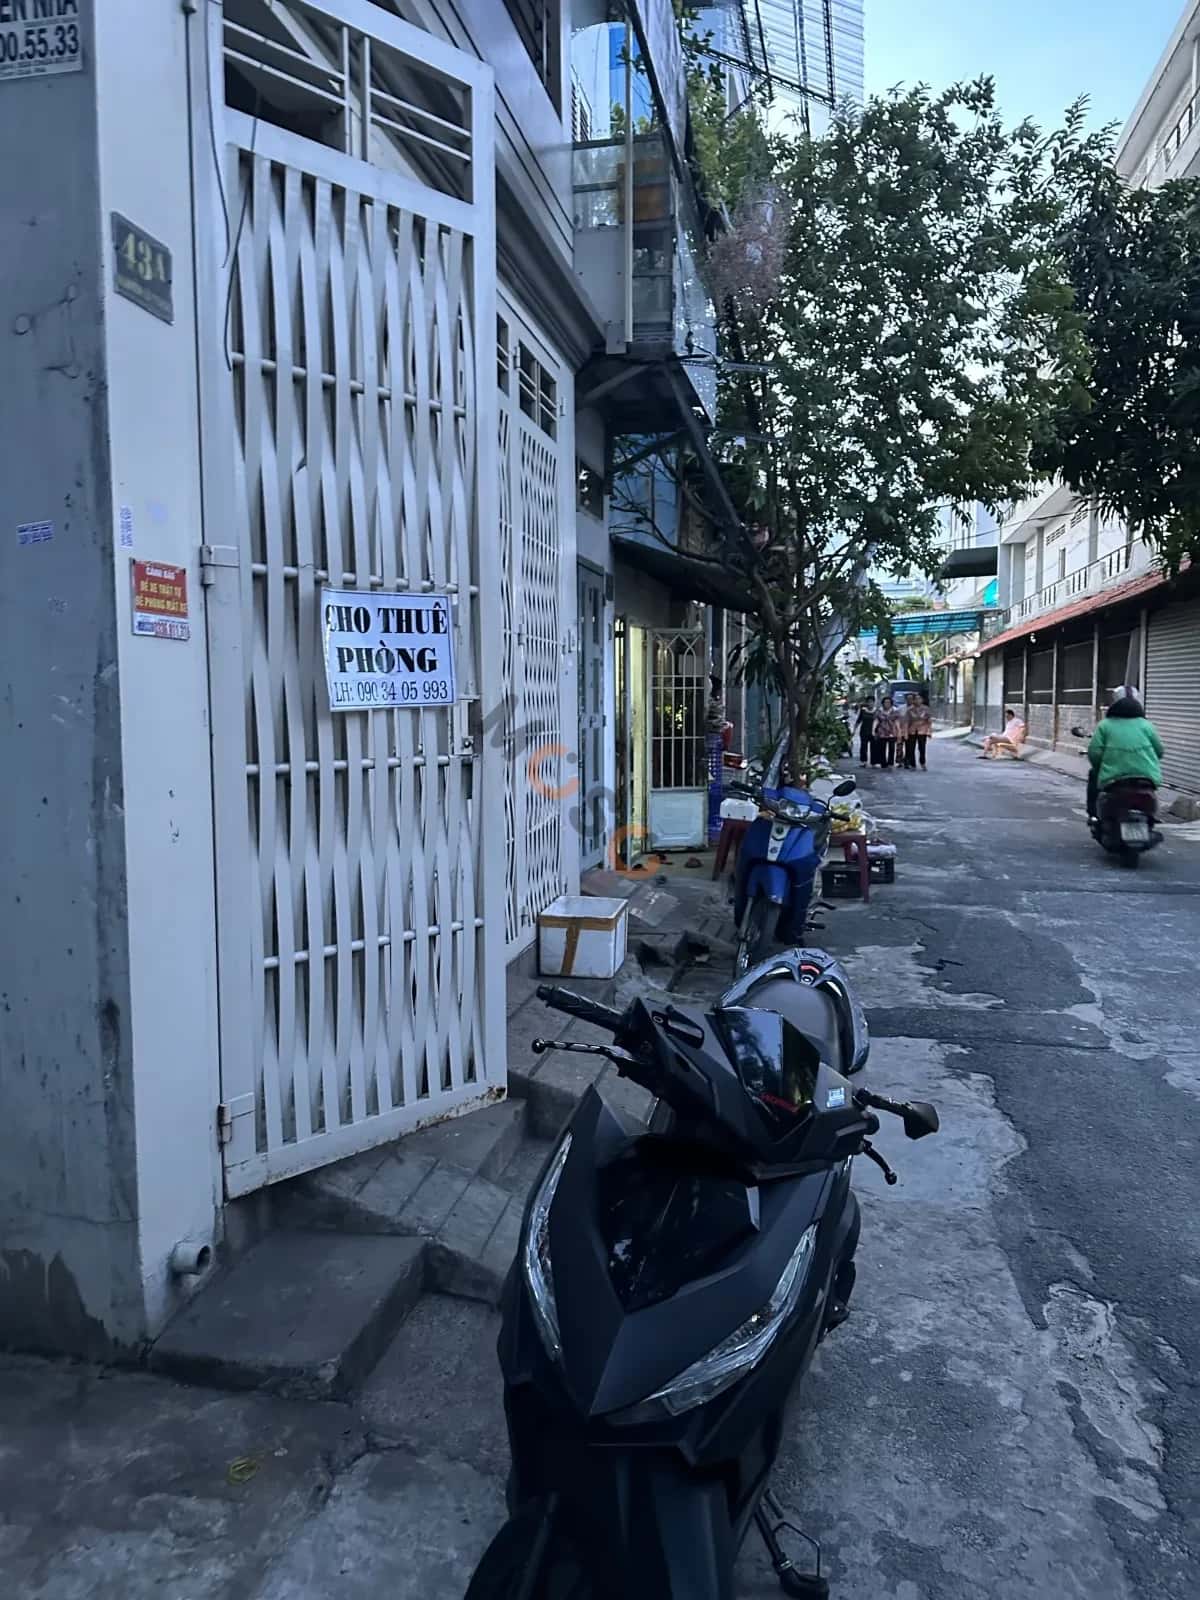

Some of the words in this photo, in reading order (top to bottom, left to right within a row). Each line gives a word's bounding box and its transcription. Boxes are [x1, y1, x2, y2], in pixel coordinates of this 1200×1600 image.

[325, 604, 371, 634] CHO
[377, 601, 448, 635] THUÊ
[336, 640, 439, 674] PHÒNG
[333, 682, 354, 703] LH:
[401, 680, 419, 700] 05
[423, 680, 448, 699] 993
